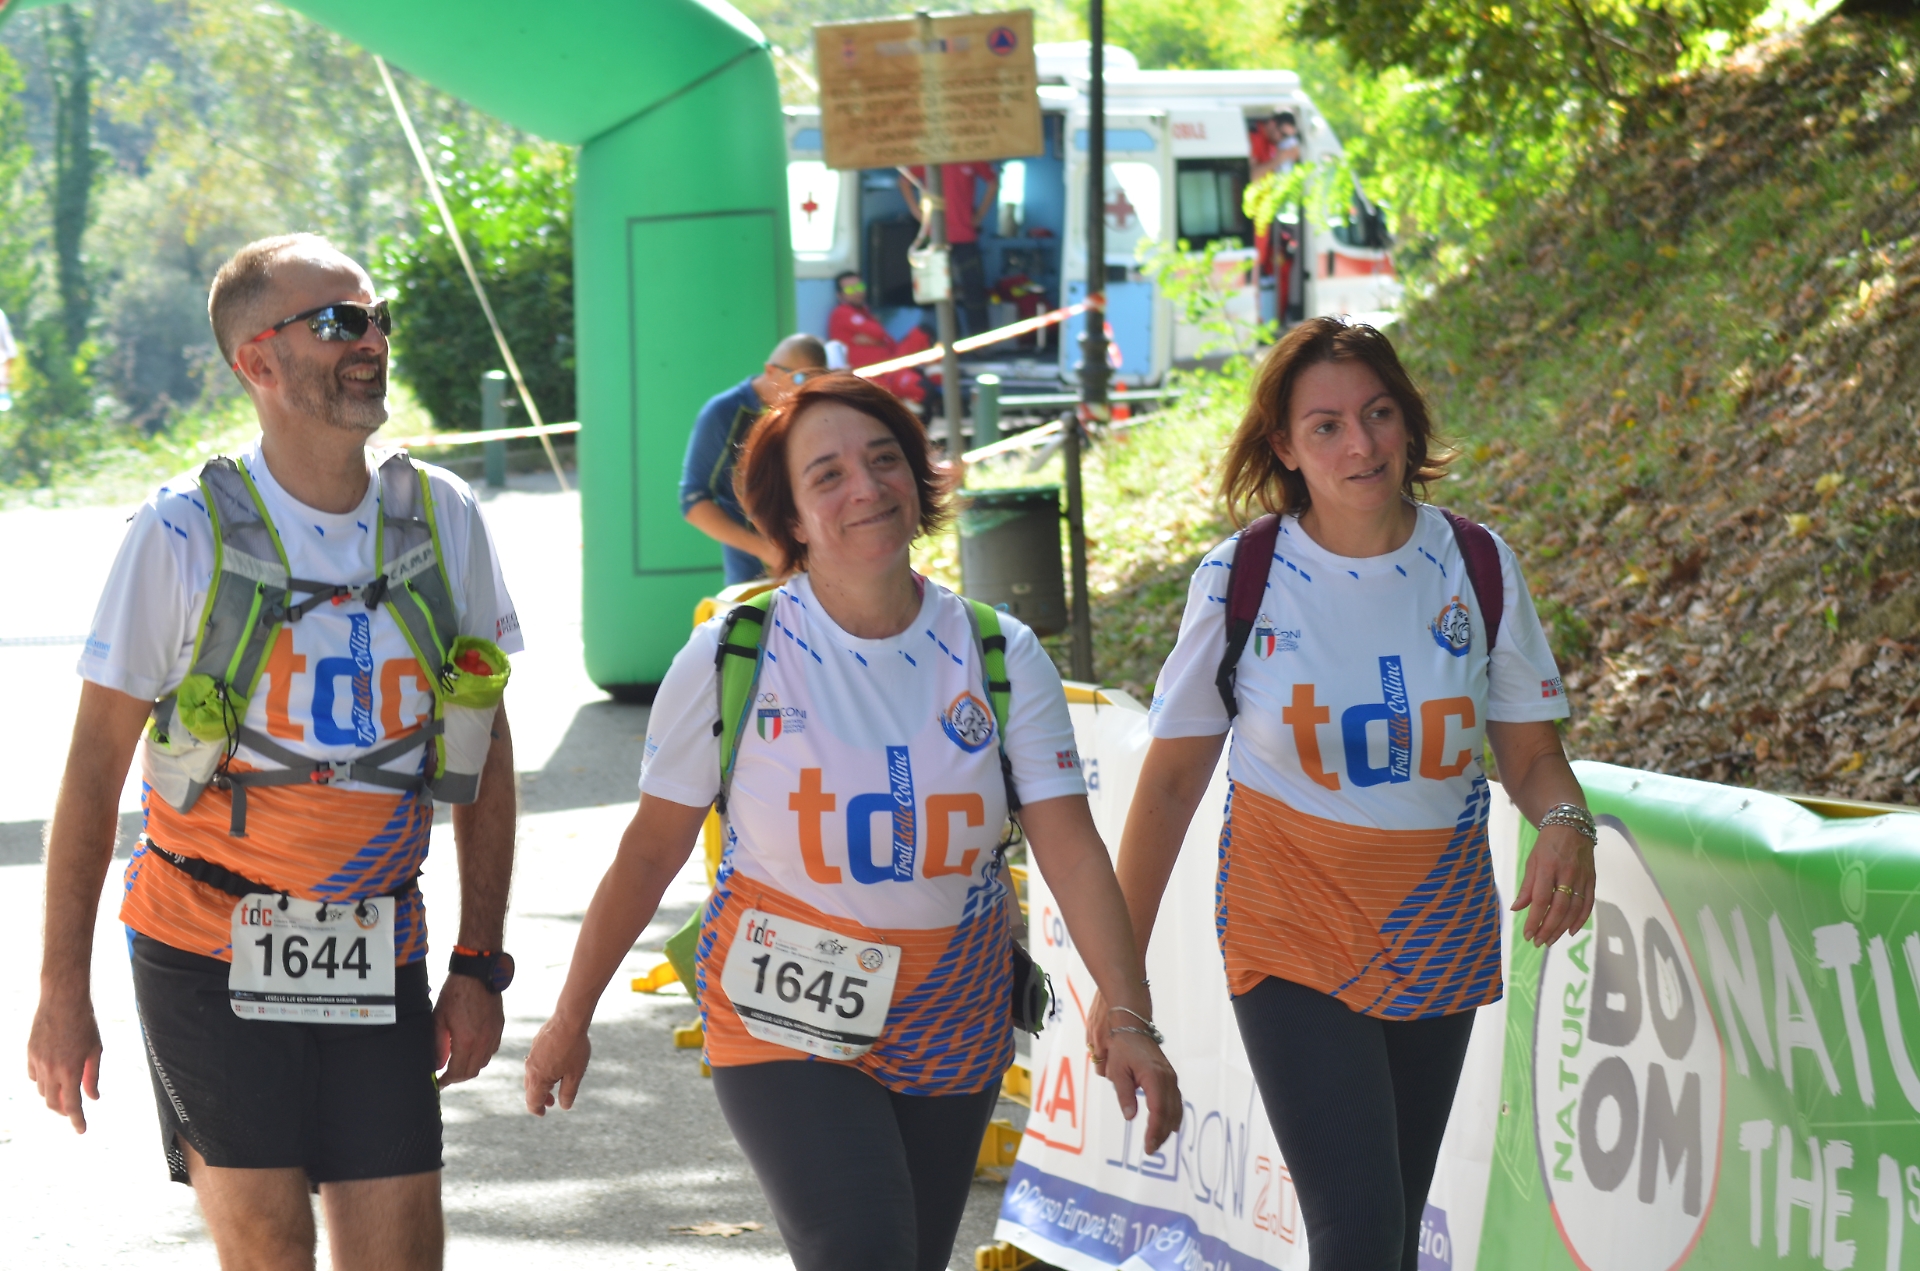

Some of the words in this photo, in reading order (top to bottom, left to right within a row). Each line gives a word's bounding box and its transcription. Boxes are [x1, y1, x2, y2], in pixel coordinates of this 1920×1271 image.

[1384, 661, 1408, 714] Colline
[1282, 655, 1476, 791] tdc
[889, 750, 912, 807] Colline
[788, 746, 985, 885] tdc
[240, 898, 273, 928] tdc
[746, 919, 776, 948] tdc
[254, 933, 372, 980] 1644
[751, 953, 869, 1020] 1645
[1058, 1198, 1105, 1240] Europa
[1739, 1118, 1857, 1271] THE
